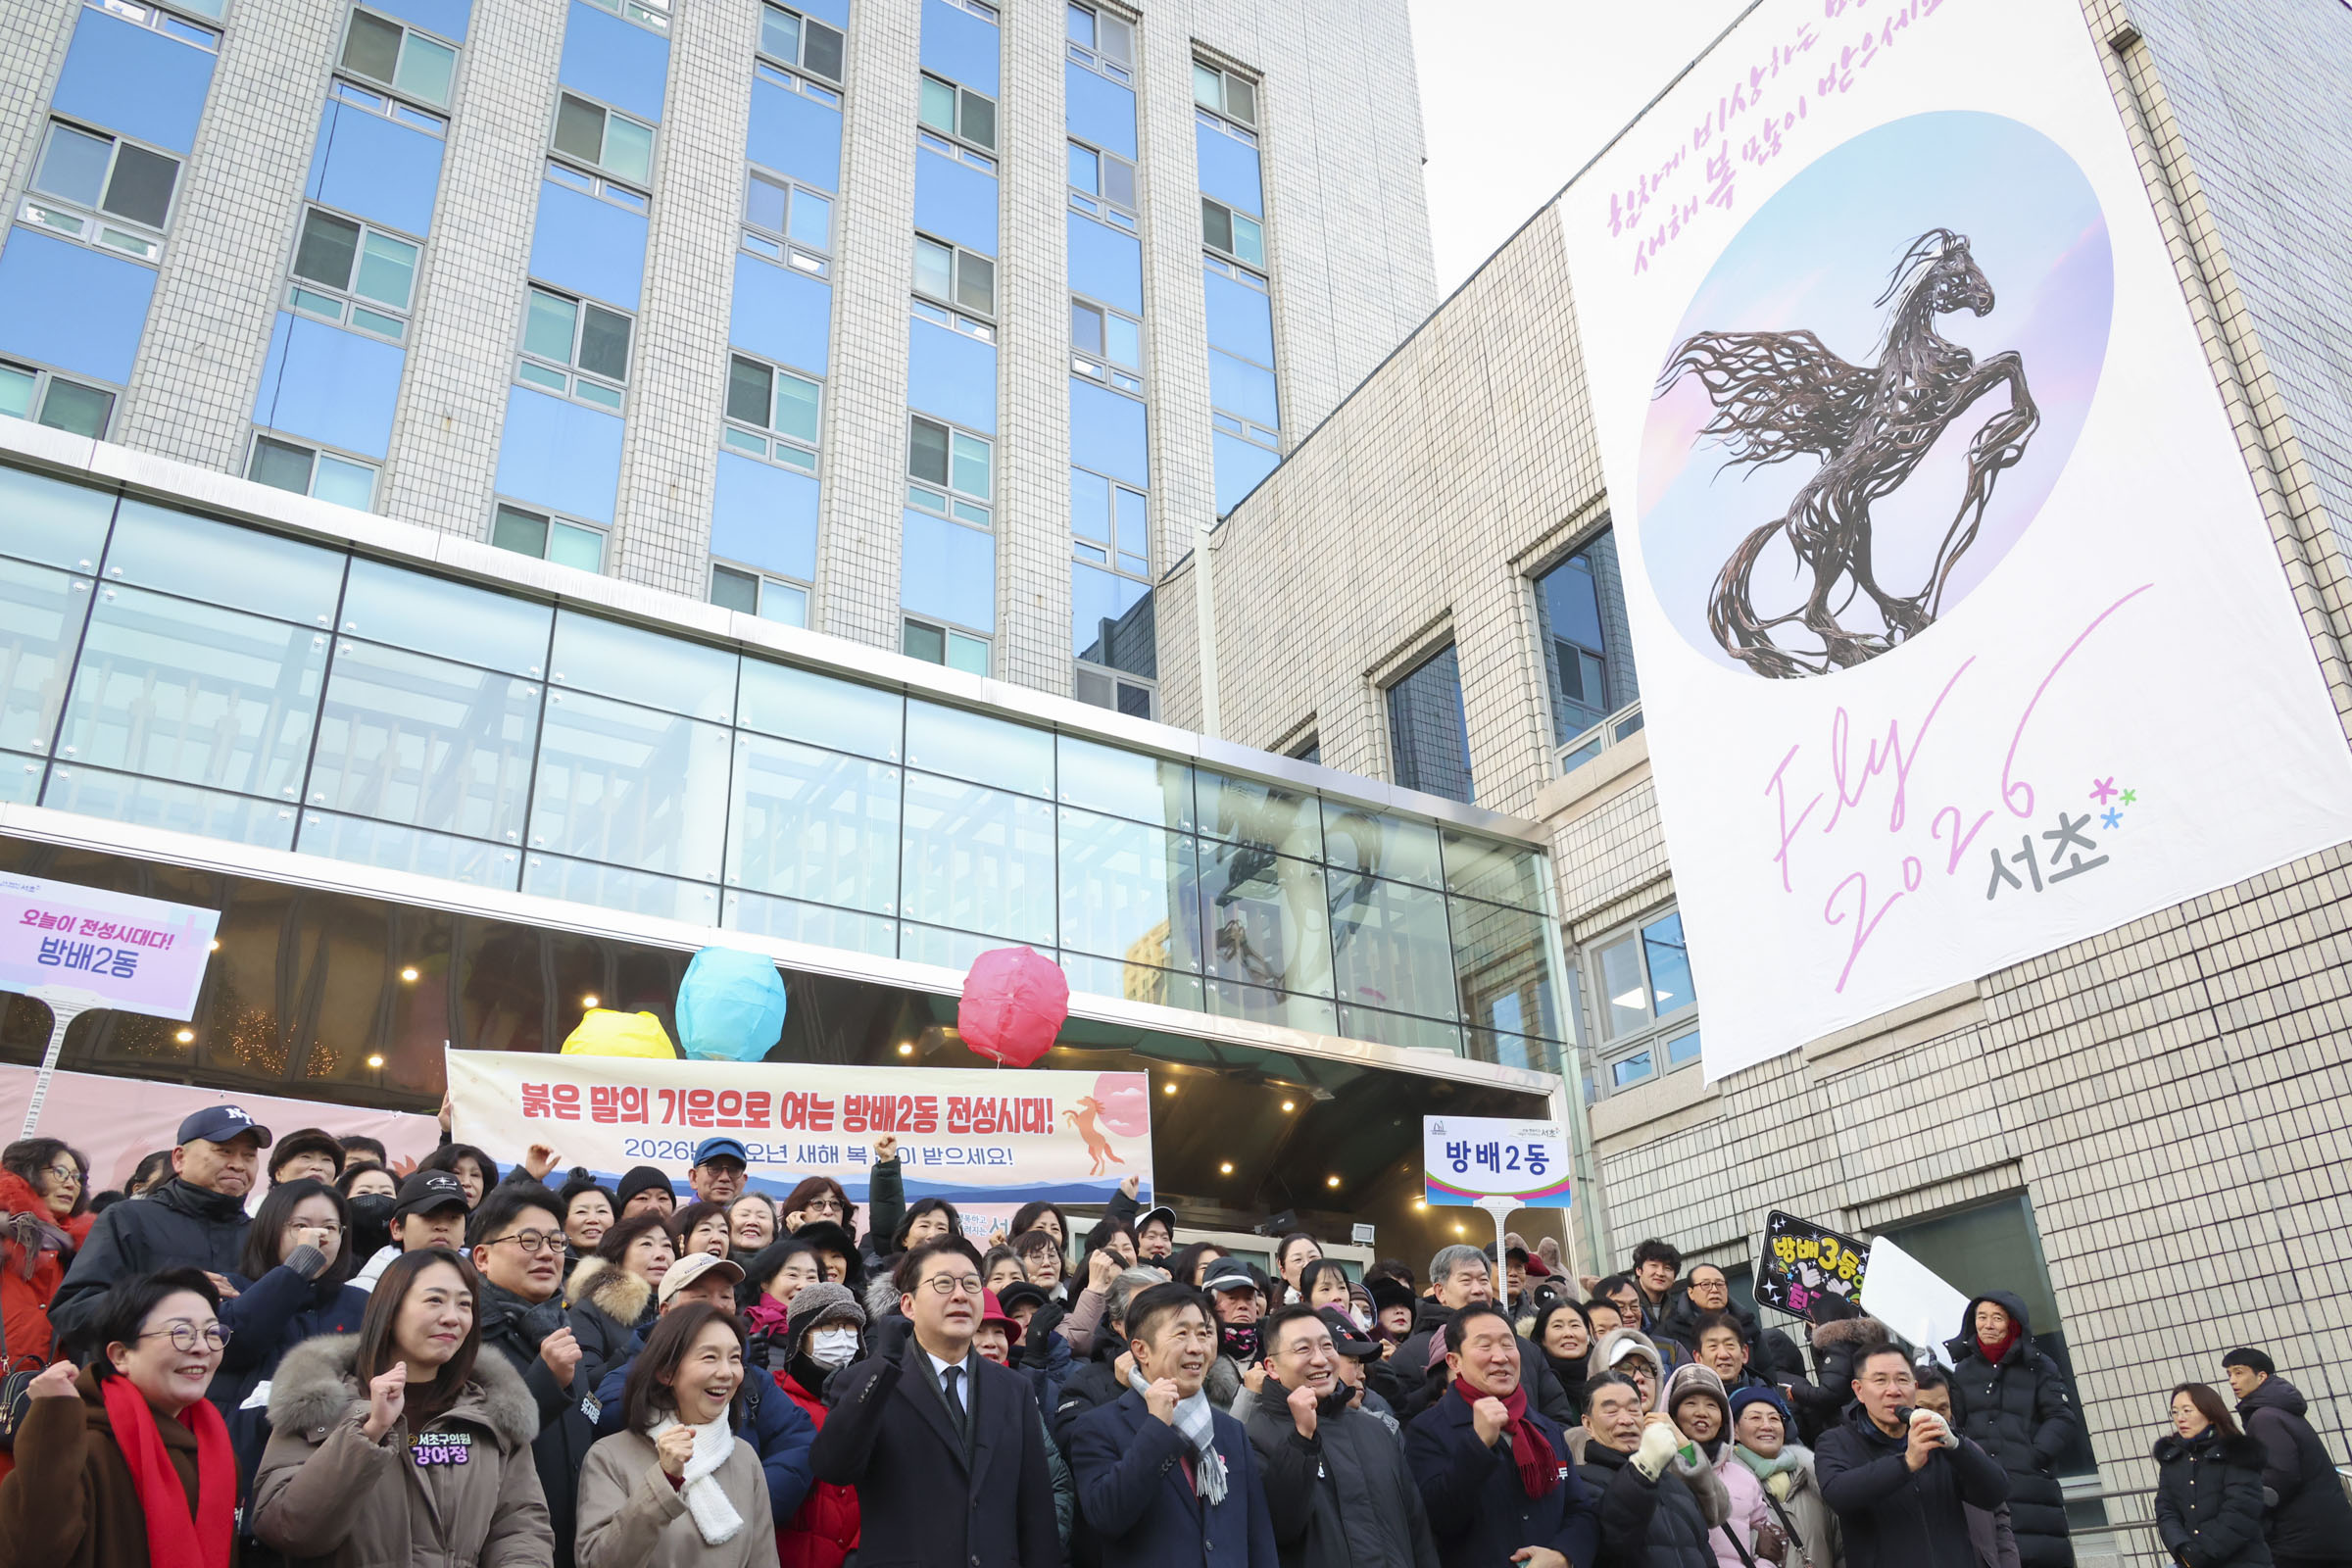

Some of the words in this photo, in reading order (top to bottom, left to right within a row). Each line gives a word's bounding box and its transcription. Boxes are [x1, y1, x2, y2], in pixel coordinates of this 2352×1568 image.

[1607, 145, 1687, 237] 힘차게
[1693, 24, 1820, 151] 비상하는
[1634, 195, 1698, 275] 새해
[1705, 139, 1737, 210] 복
[1742, 95, 1807, 166] 많이
[1764, 655, 1977, 894] Fly
[1824, 582, 2155, 994] 2026
[1986, 811, 2110, 902] 서초
[19, 908, 77, 933] 오늘이
[79, 918, 175, 951] 전성시대다!
[37, 937, 139, 979] 방배2동
[225, 1107, 252, 1125] NY
[521, 1083, 581, 1120] 붉은
[591, 1086, 649, 1124] 말의
[659, 1089, 771, 1128] 기운으로
[781, 1091, 834, 1132] 여는
[844, 1095, 938, 1133] 방배2동
[948, 1097, 1054, 1134] 전성시대!
[746, 1143, 788, 1164] 오년
[796, 1144, 839, 1164] 새해
[847, 1146, 868, 1165] 복
[922, 1146, 1013, 1166] 받으세요!
[1446, 1140, 1550, 1176] 방배2동
[1773, 1236, 1860, 1279] 방배3동
[413, 1446, 468, 1465] 강여정
[418, 1433, 471, 1446] 서초구의원
